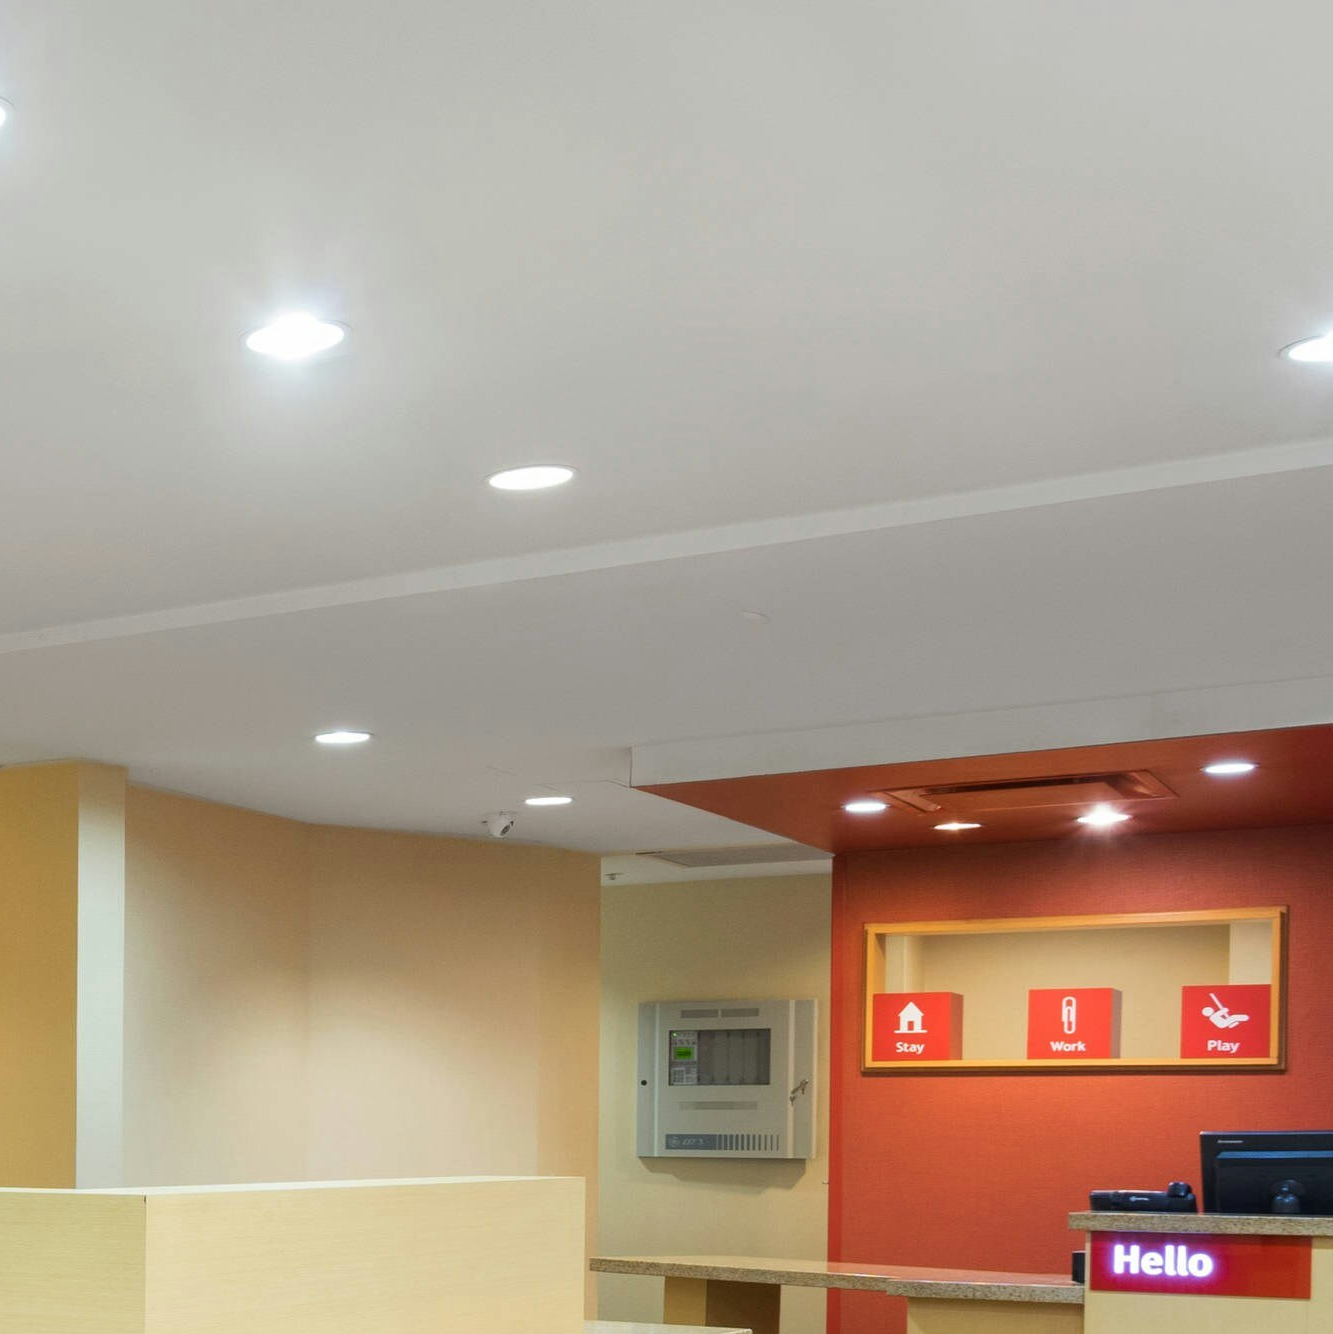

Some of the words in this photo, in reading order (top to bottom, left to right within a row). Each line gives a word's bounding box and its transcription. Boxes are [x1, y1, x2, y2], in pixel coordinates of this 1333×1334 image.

[895, 1041, 925, 1055] Stay
[1050, 1041, 1086, 1052] Work
[1207, 1040, 1240, 1053] Play
[1113, 1244, 1214, 1278] Hello
